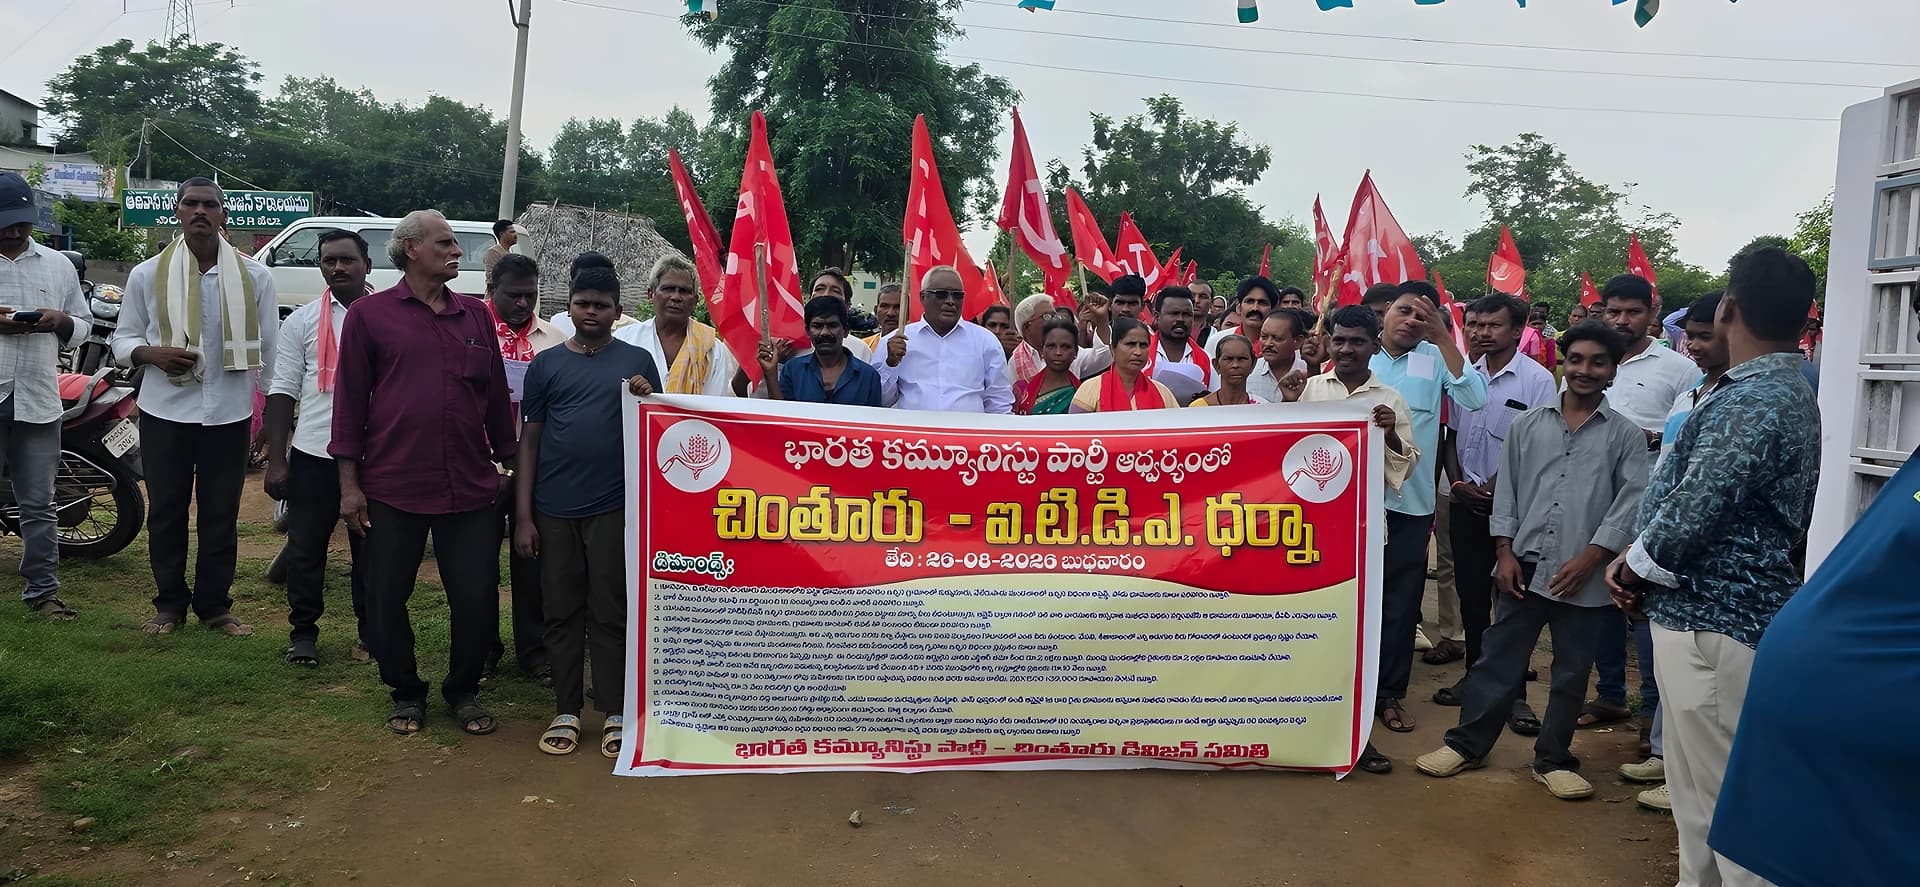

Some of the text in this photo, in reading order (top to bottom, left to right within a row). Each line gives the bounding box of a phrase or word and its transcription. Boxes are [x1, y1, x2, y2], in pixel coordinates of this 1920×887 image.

[784, 436, 1232, 487] భారత కమ్యూనిస్టు పార్టీ ఆధ్వర్యంలో
[712, 485, 925, 544] చింతూరు
[1205, 492, 1321, 566] ధర్నా
[885, 548, 915, 568] తేది
[926, 551, 1058, 569] 26-08-2026
[1061, 552, 1146, 573] బుధవారం
[735, 738, 807, 759] భారత
[813, 738, 931, 760] కమ్యూనిస్టు
[1121, 741, 1198, 758] డివిజన్
[1203, 742, 1270, 759] సమితి
